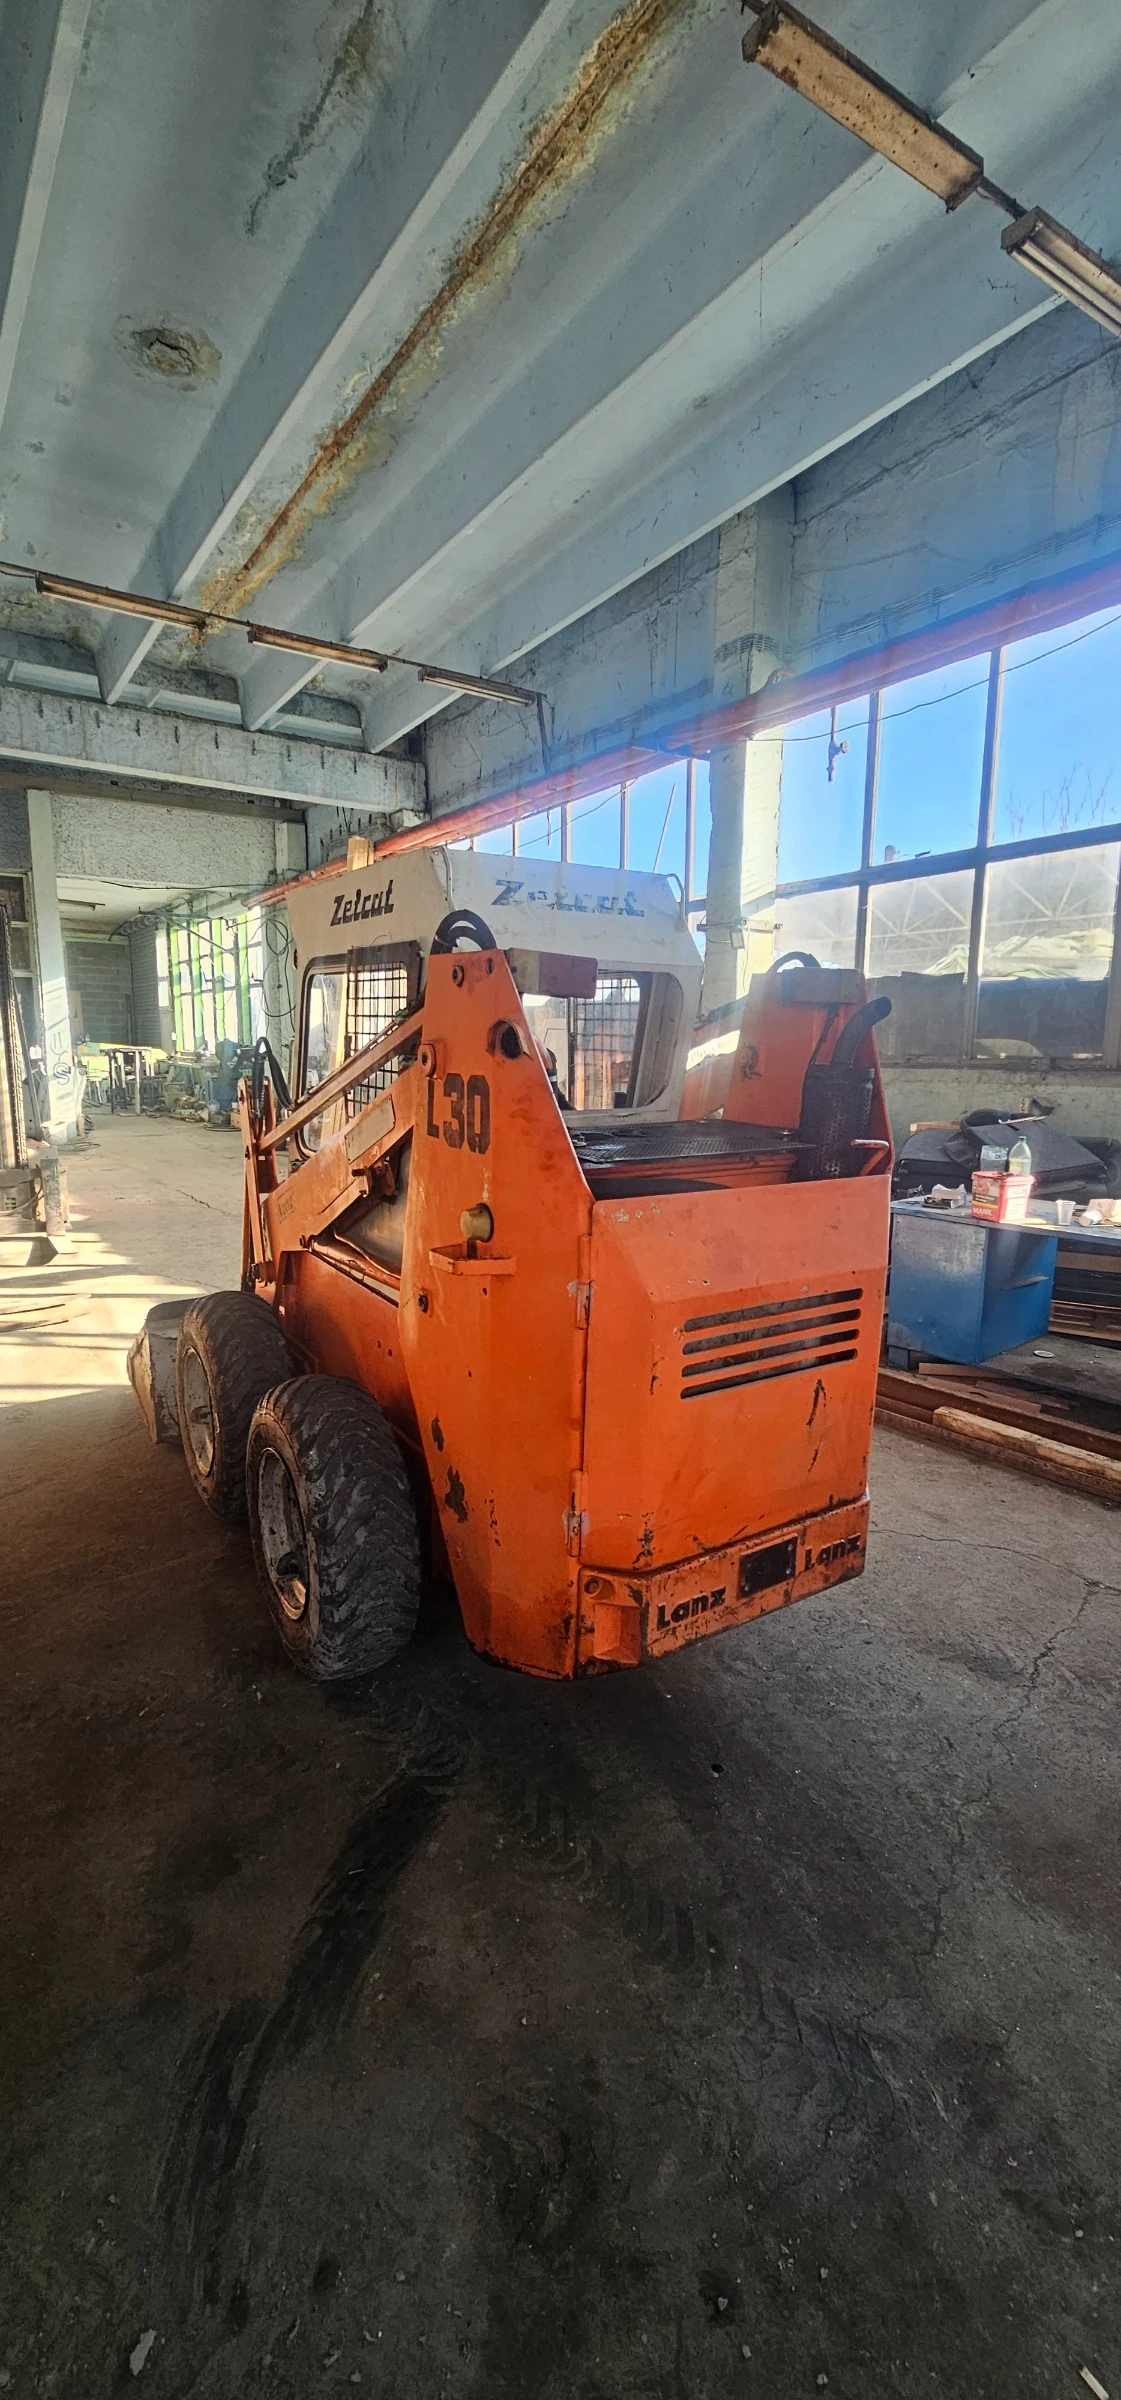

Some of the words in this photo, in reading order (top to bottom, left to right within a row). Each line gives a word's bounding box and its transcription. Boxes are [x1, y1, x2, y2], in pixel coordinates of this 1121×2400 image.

[426, 1073, 491, 1155] L30
[804, 1533, 861, 1571] Lanz
[656, 1587, 727, 1630] Lanz
